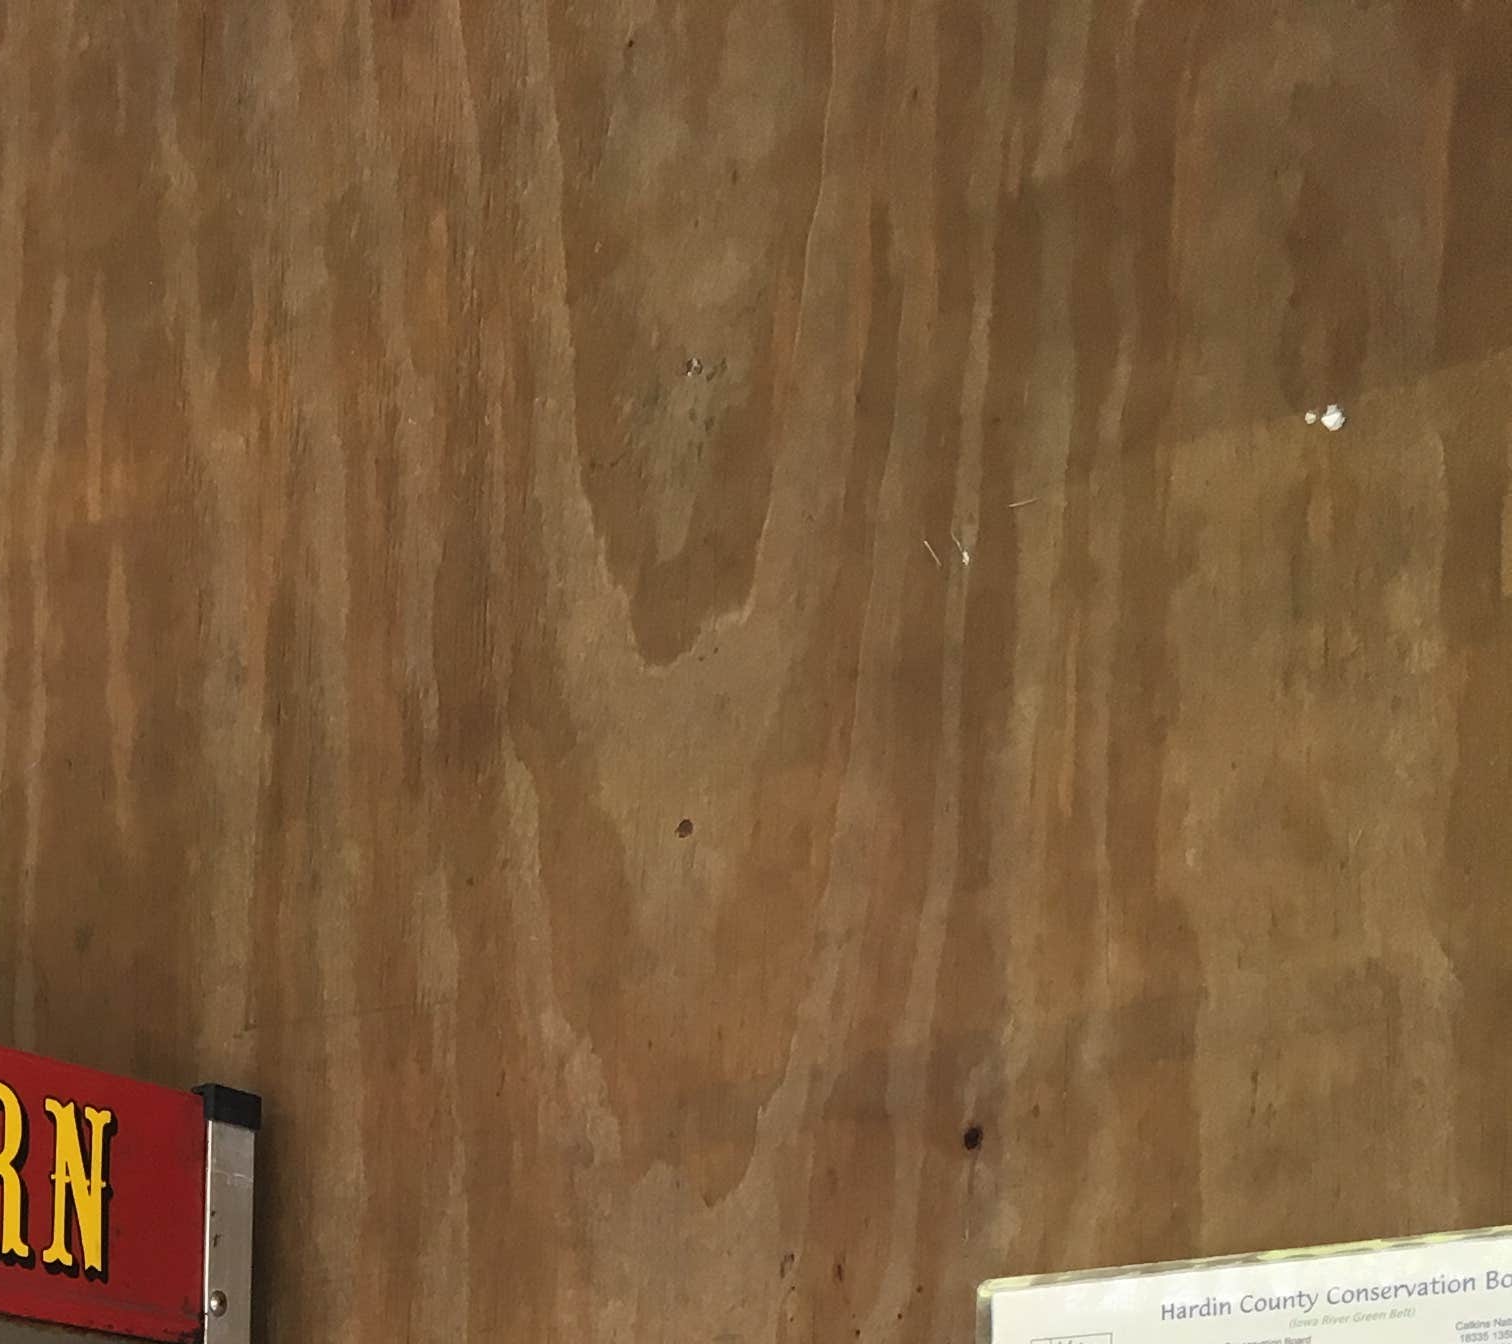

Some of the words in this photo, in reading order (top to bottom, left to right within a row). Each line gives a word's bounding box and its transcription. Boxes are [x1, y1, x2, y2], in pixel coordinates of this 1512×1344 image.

[1161, 1297, 1231, 1320] Hardin
[1240, 1290, 1319, 1313] County
[1327, 1274, 1476, 1305] Conservation
[1322, 1315, 1350, 1326] River
[1353, 1312, 1386, 1323] Green
[1389, 1308, 1416, 1319] Belt)
